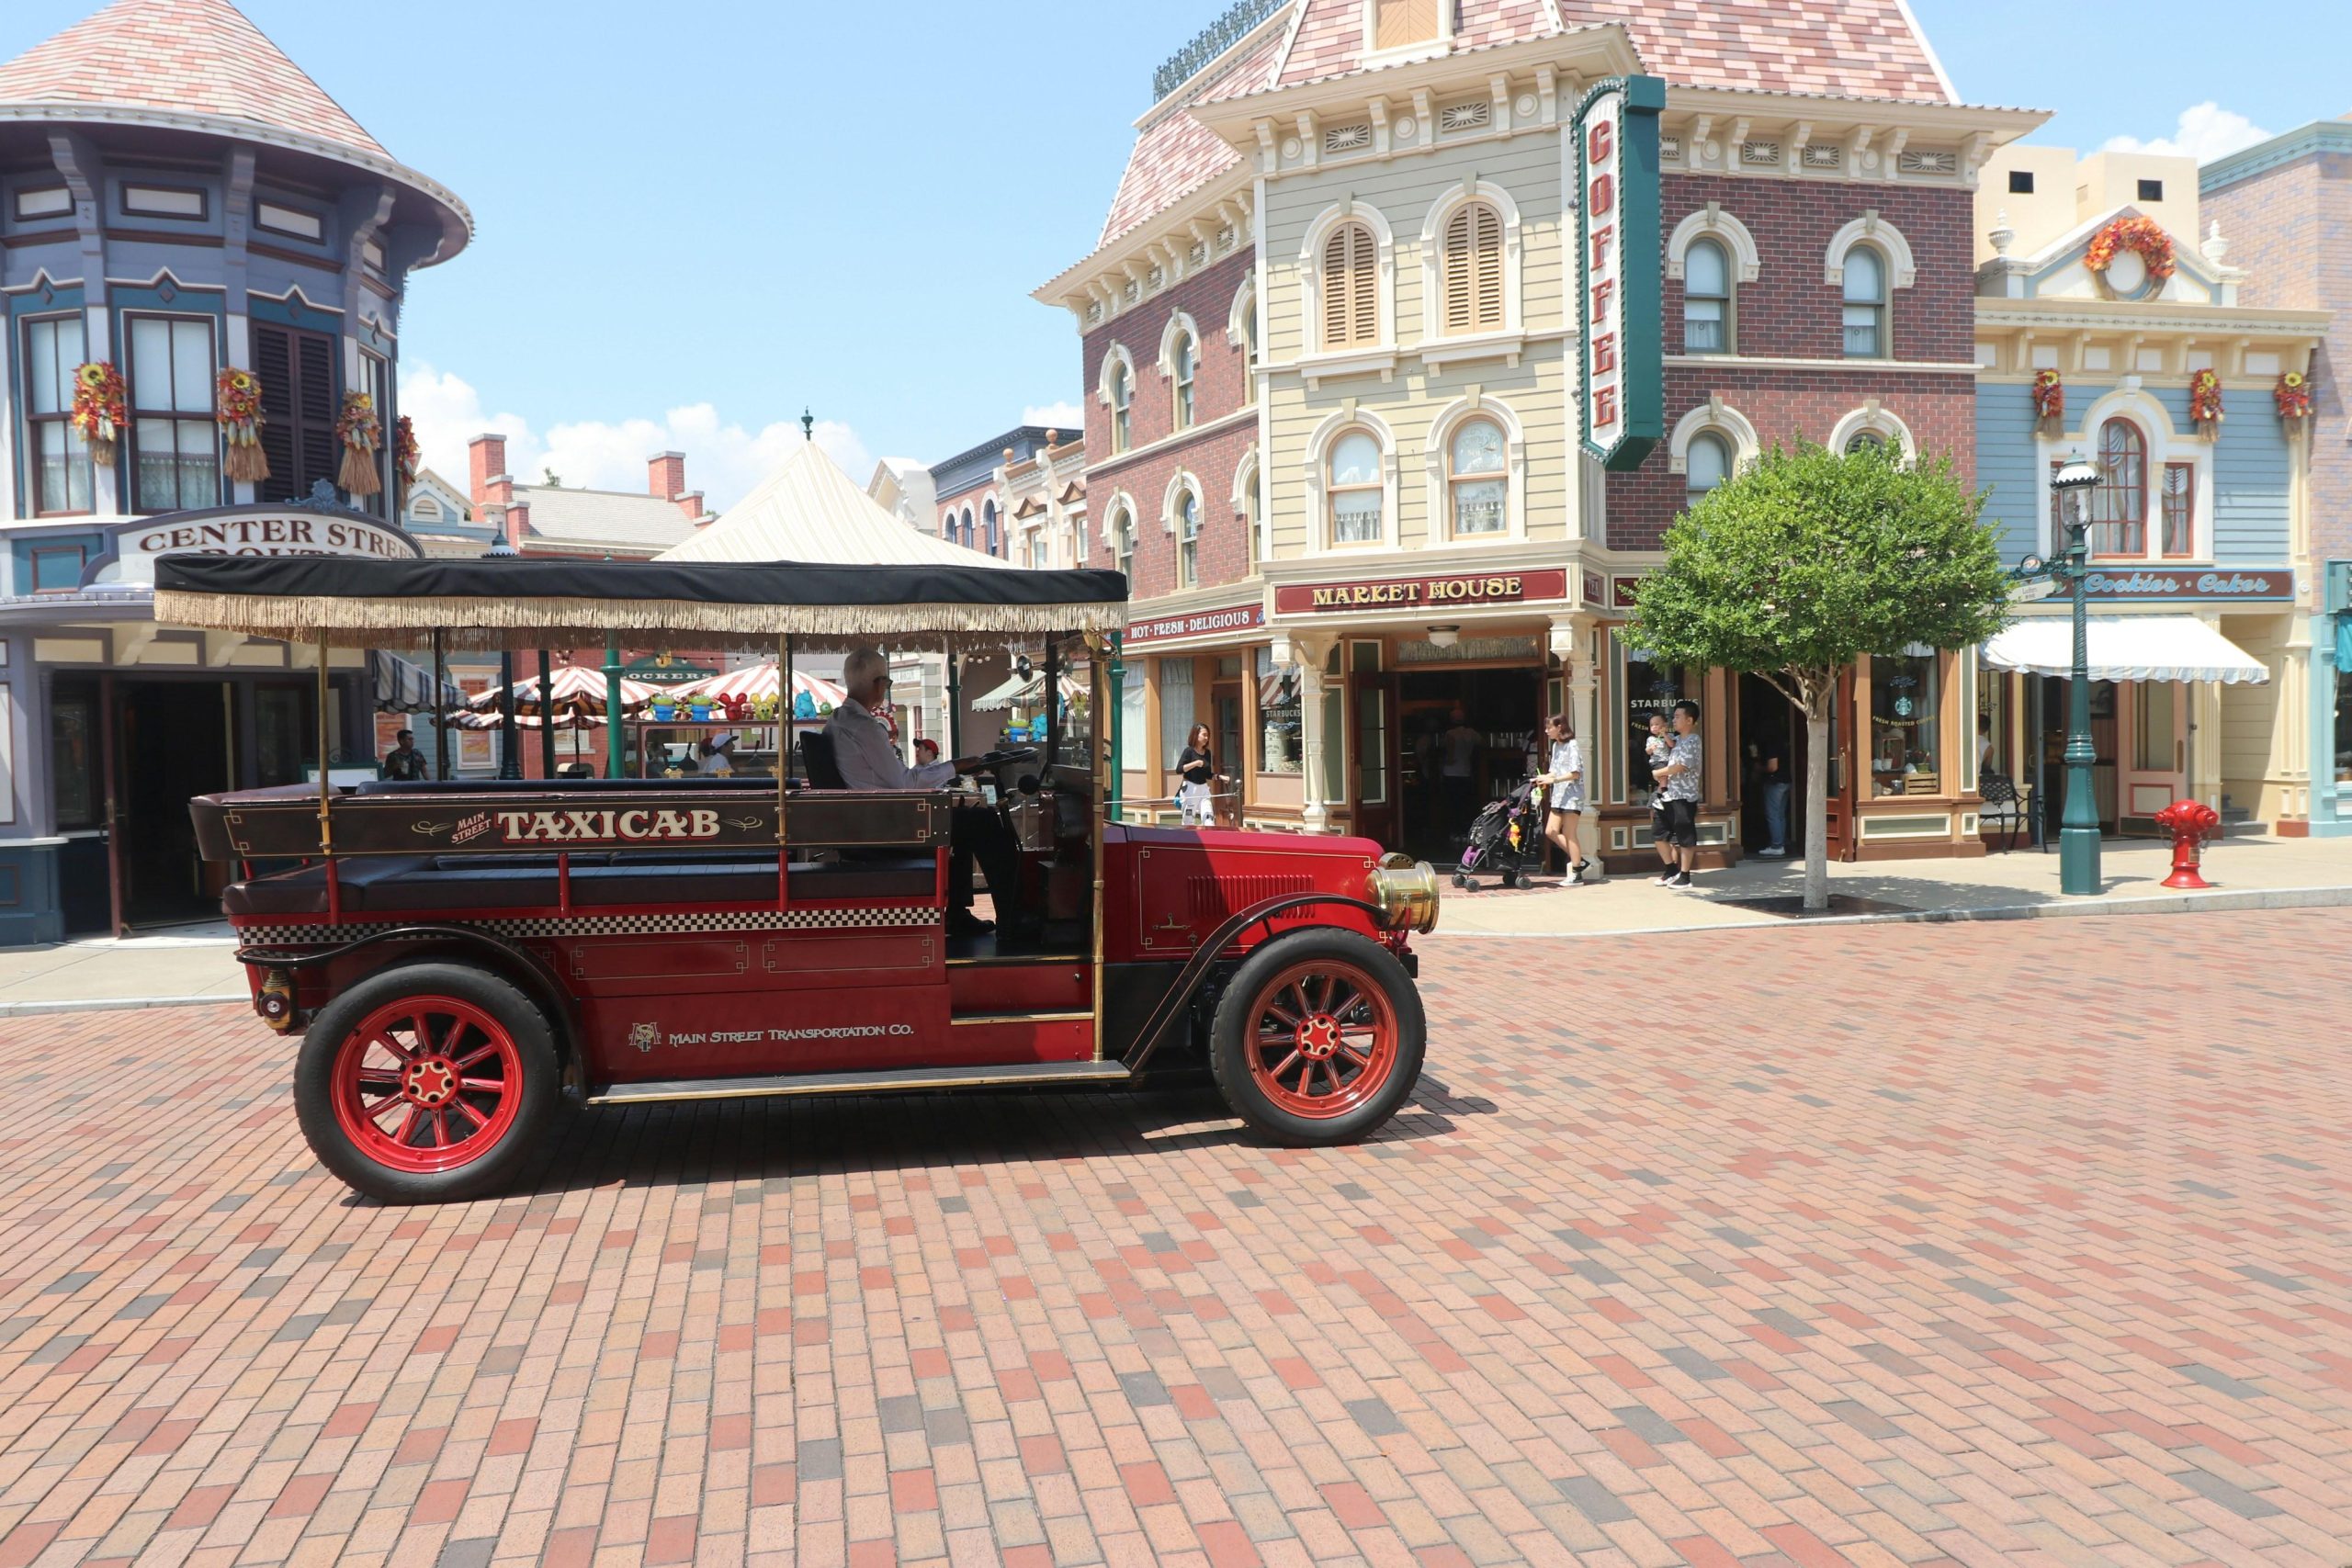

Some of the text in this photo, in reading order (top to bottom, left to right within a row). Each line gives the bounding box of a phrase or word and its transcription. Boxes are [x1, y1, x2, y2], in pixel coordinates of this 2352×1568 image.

[1589, 118, 1616, 430] COFFEE
[139, 519, 313, 552] CENTER
[1311, 576, 1522, 606] MARKET HOUSE
[2084, 572, 2180, 593] Cookies
[2197, 572, 2271, 593] Cakes
[623, 671, 712, 681] OCKERS
[1265, 709, 1301, 718] STARBUCKS
[451, 818, 492, 843] STREET
[457, 812, 485, 829] MAIN
[495, 808, 721, 842] TAXICAB
[669, 1023, 914, 1047] MAIN STREET TRANSPORTATION CO.
